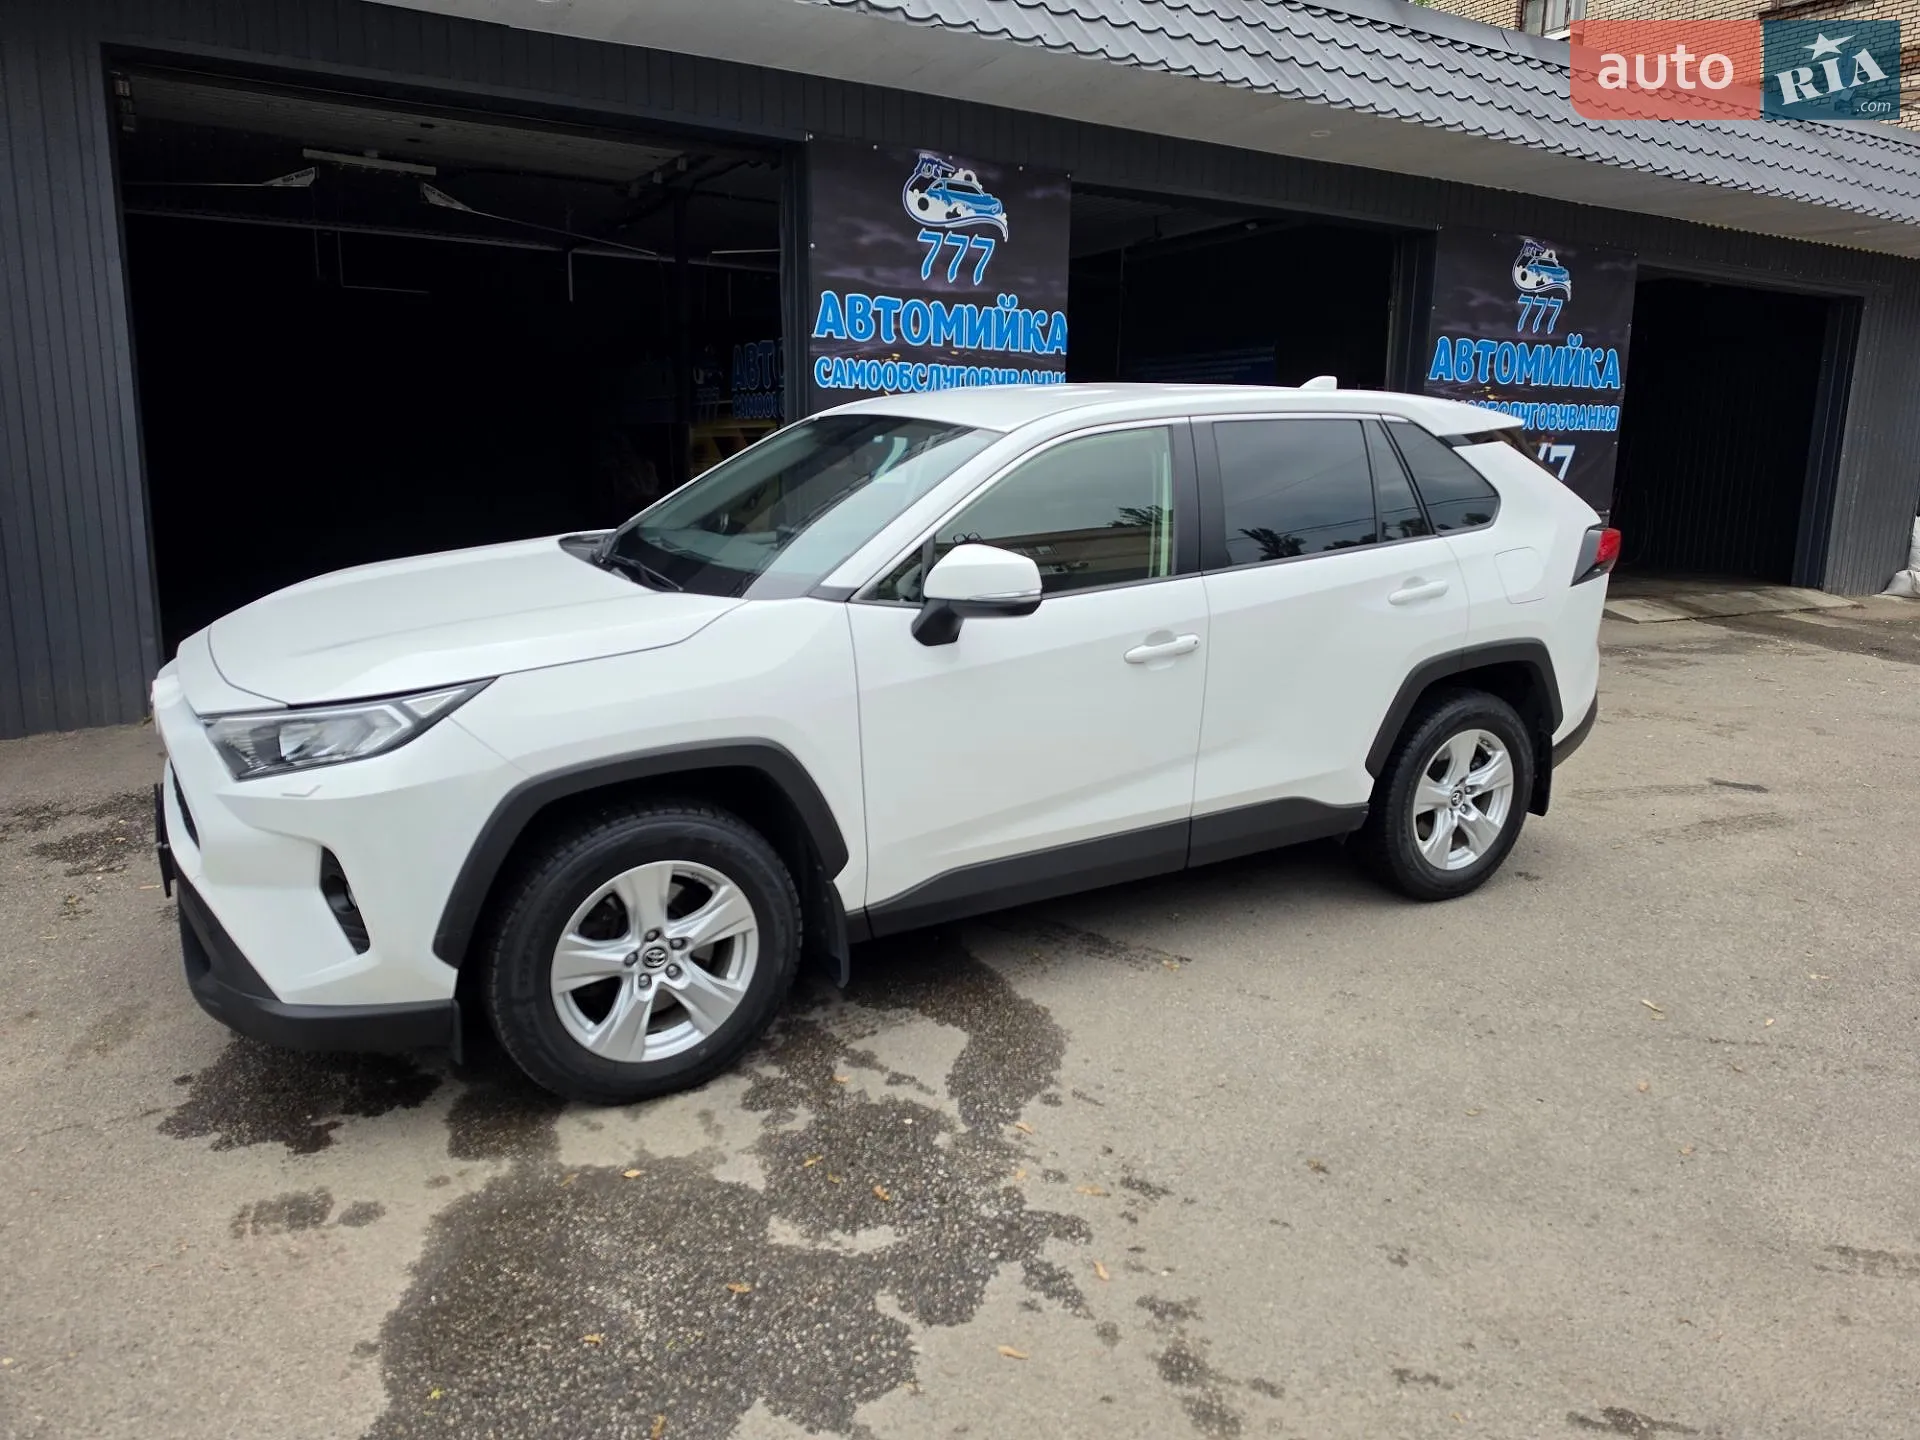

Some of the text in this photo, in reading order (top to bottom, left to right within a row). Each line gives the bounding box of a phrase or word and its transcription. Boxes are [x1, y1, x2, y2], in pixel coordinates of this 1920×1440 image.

[917, 227, 995, 286] 777
[813, 290, 1067, 355] АВТОМИЙКА
[1517, 294, 1563, 334] 777
[1428, 333, 1621, 390] АВТОМИЙКА
